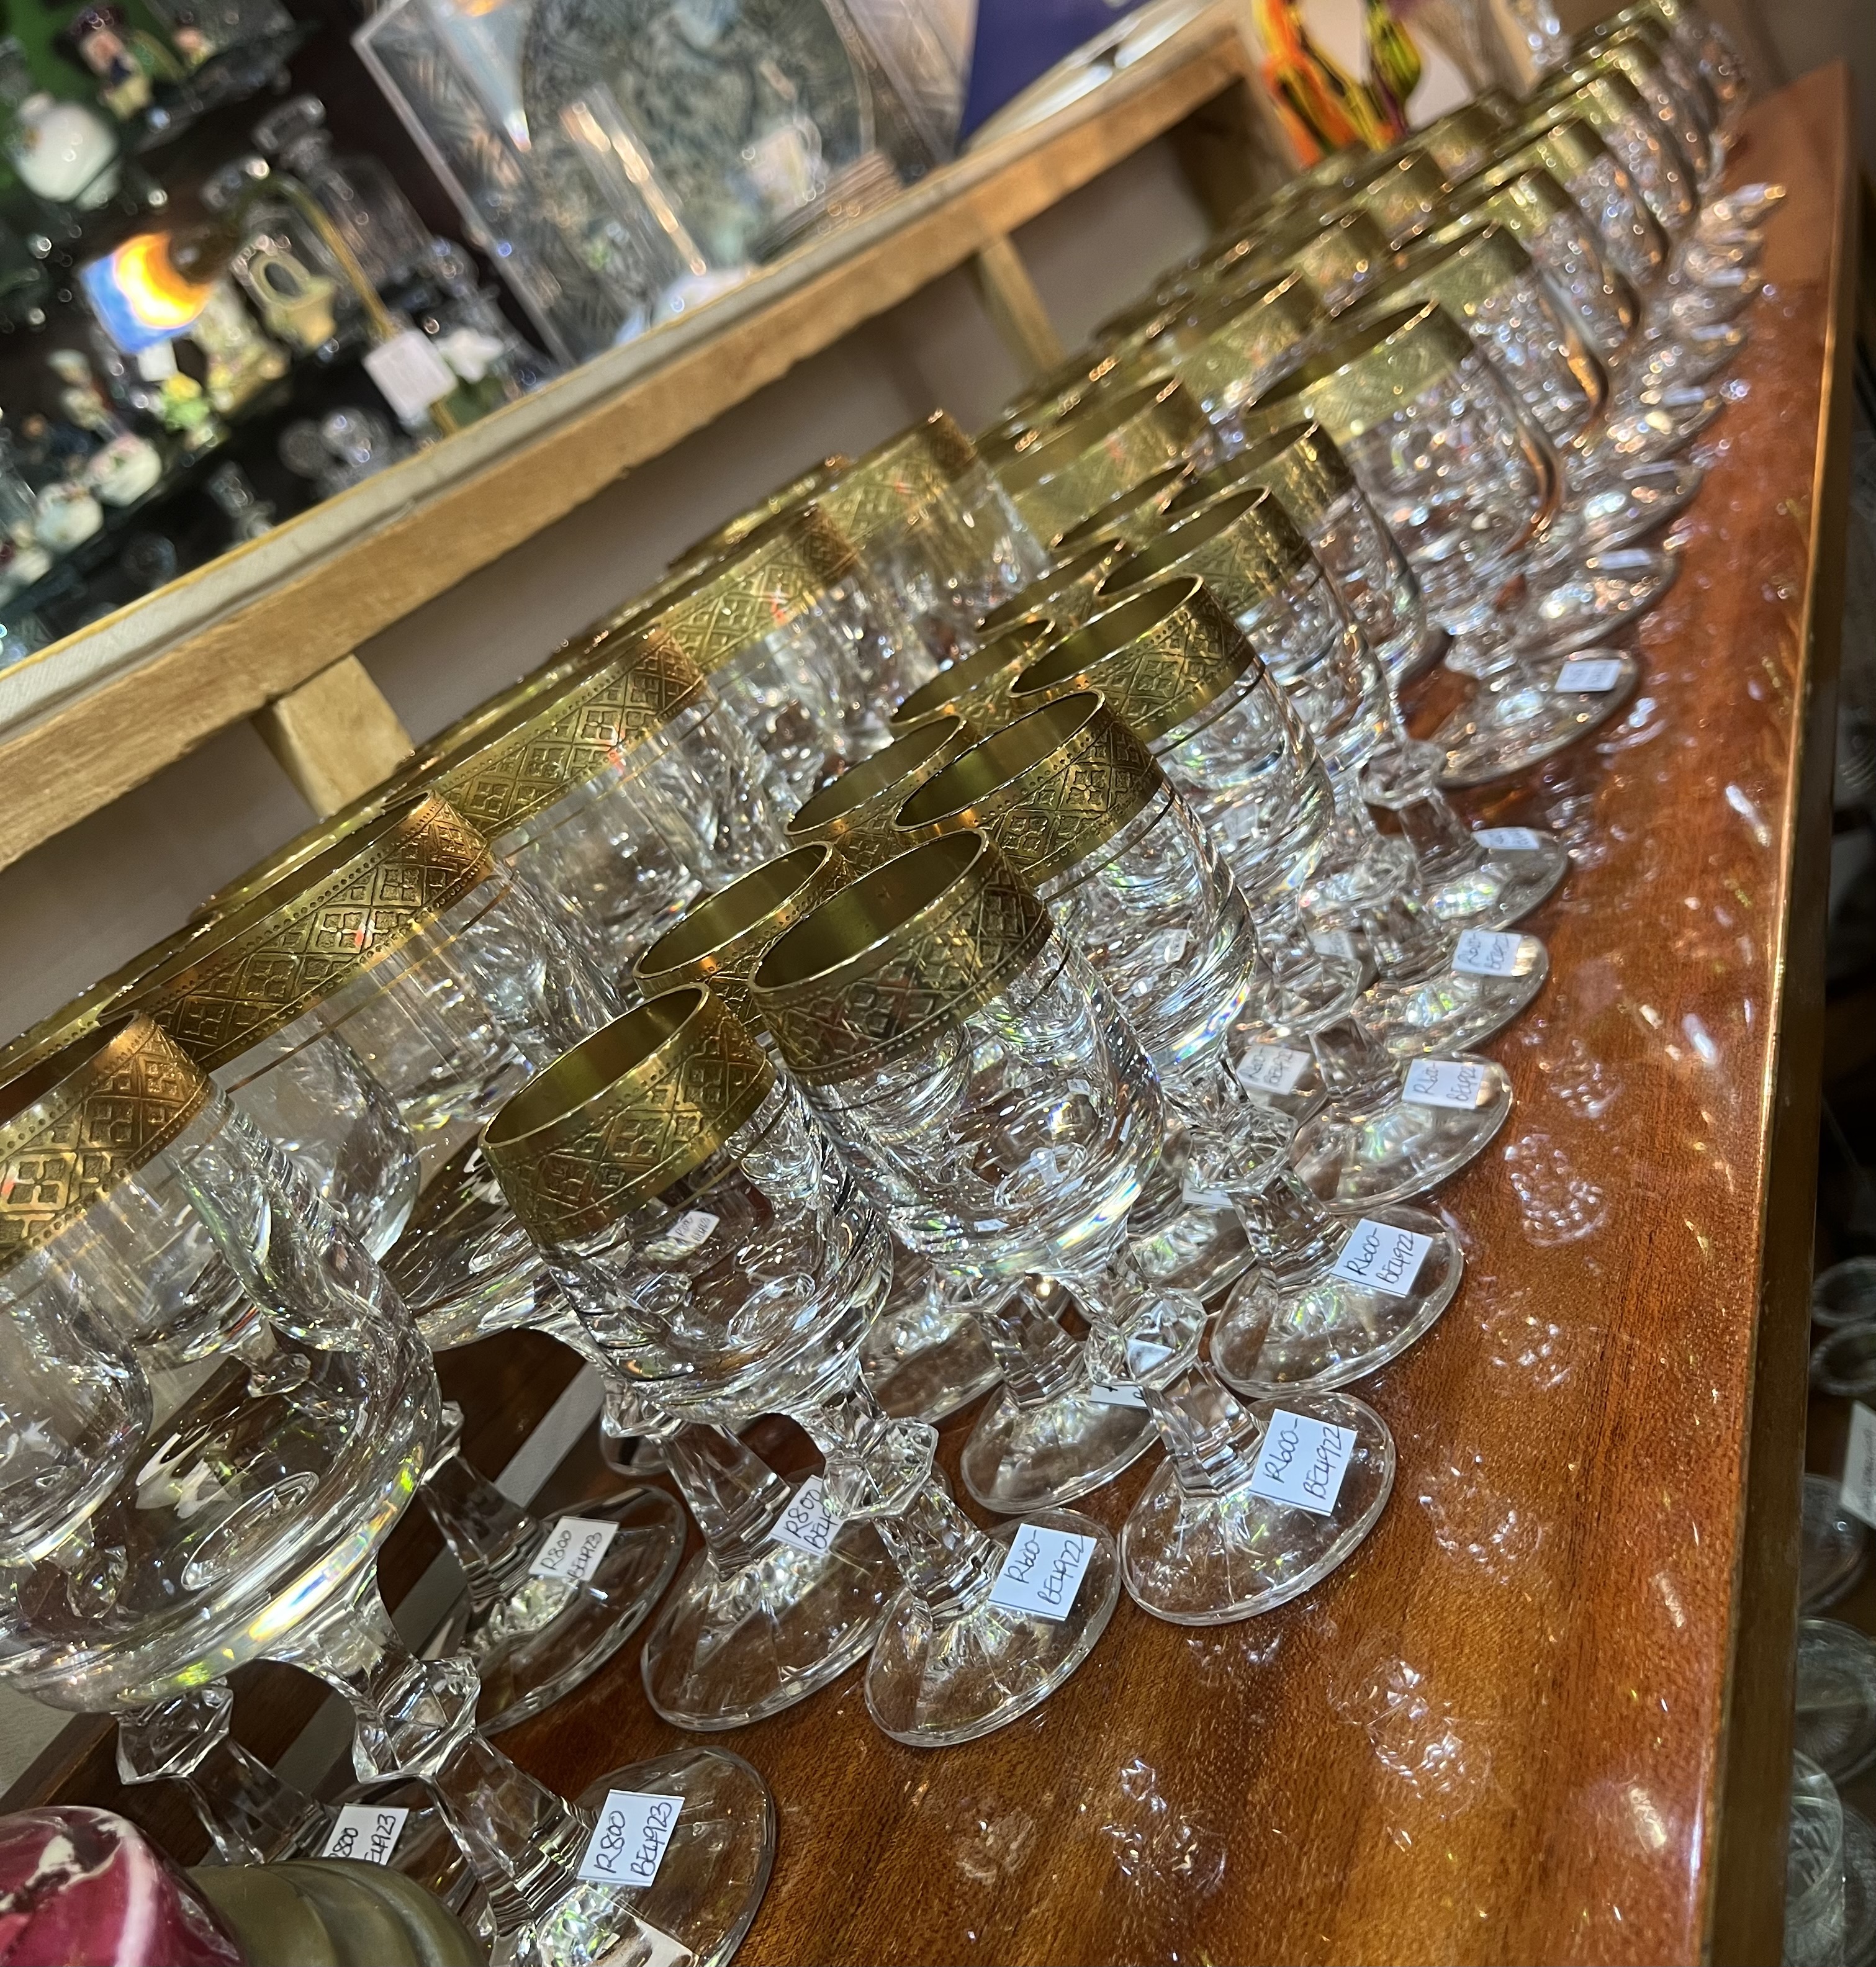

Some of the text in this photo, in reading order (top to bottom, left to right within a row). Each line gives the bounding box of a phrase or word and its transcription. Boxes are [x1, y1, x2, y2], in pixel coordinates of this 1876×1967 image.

[1375, 1231, 1414, 1284] BE4922
[1303, 1425, 1341, 1500] BE4922
[539, 1529, 572, 1570] R800
[1037, 1535, 1085, 1605] BE4922
[327, 1827, 359, 1858] 800
[364, 1813, 397, 1863] E4923
[593, 1810, 626, 1874] R800
[630, 1802, 672, 1877] BE4923
